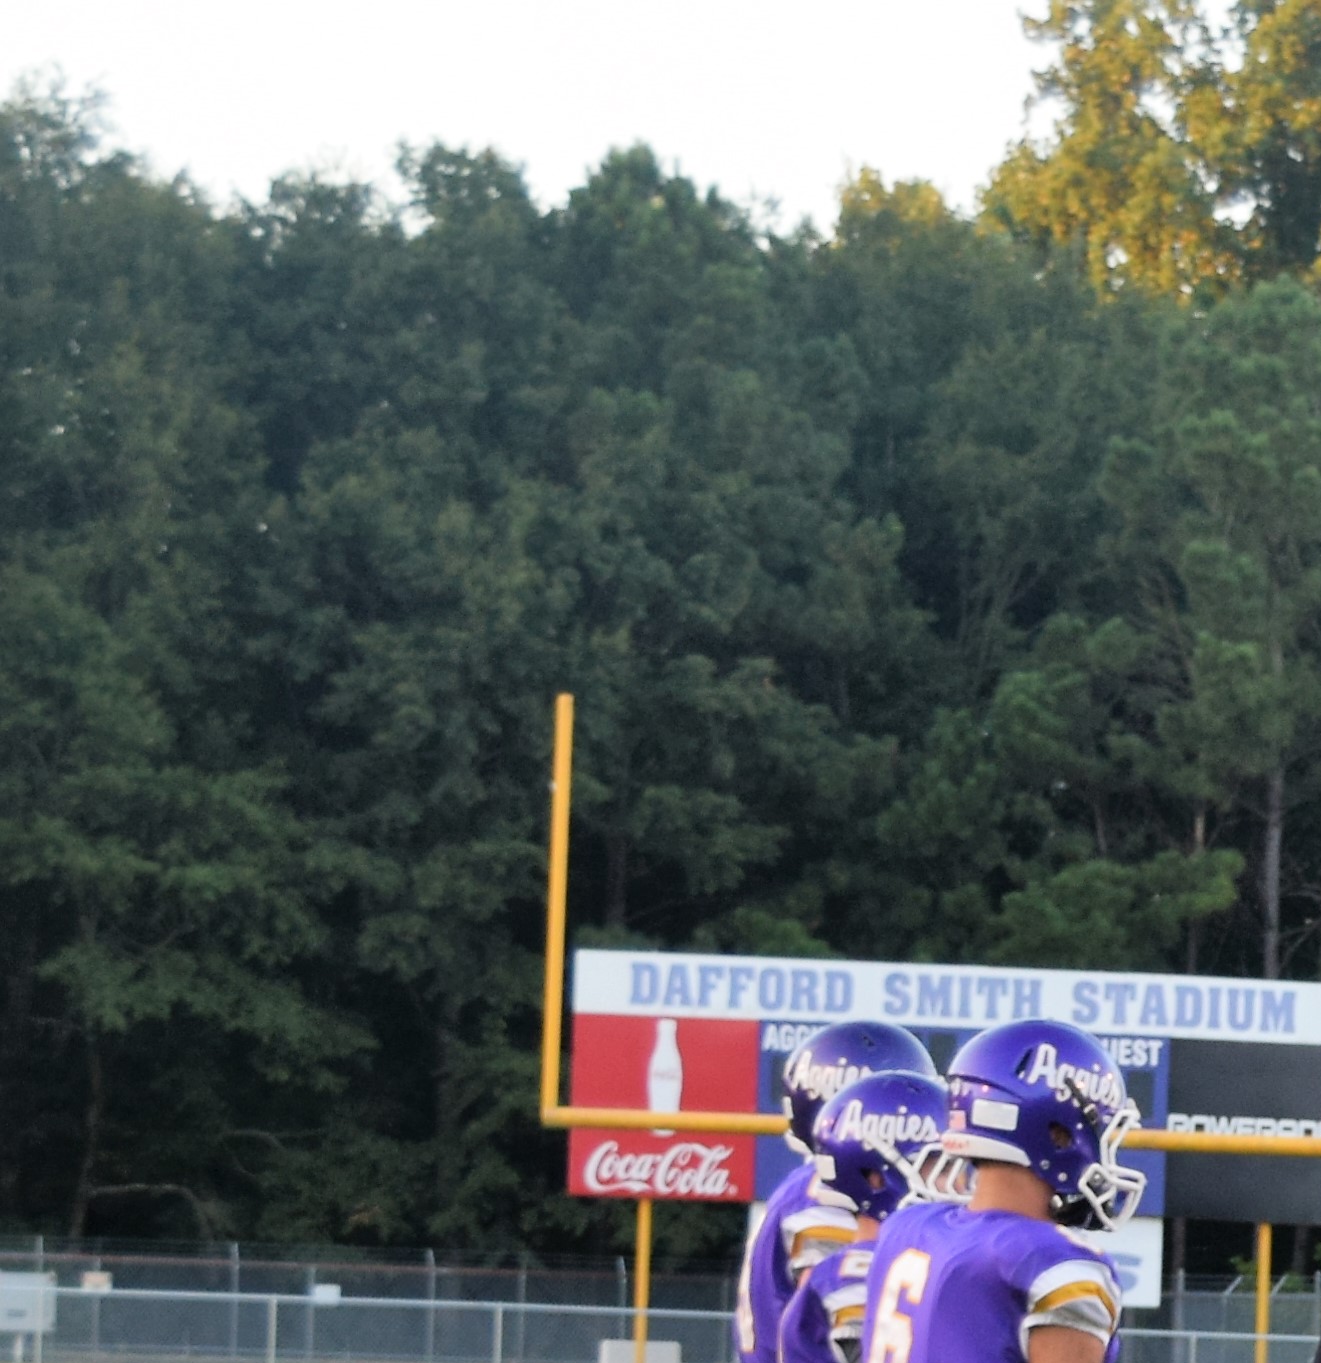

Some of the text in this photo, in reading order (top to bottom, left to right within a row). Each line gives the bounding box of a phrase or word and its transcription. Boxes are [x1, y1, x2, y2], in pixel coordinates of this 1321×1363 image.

[631, 962, 1298, 1034] DAFFORD SMITH STADIUM
[1027, 1043, 1121, 1110] Aggies
[1102, 1038, 1163, 1067] UEST
[837, 1099, 940, 1150] Aggies
[583, 1140, 734, 1196] Coca-Cola
